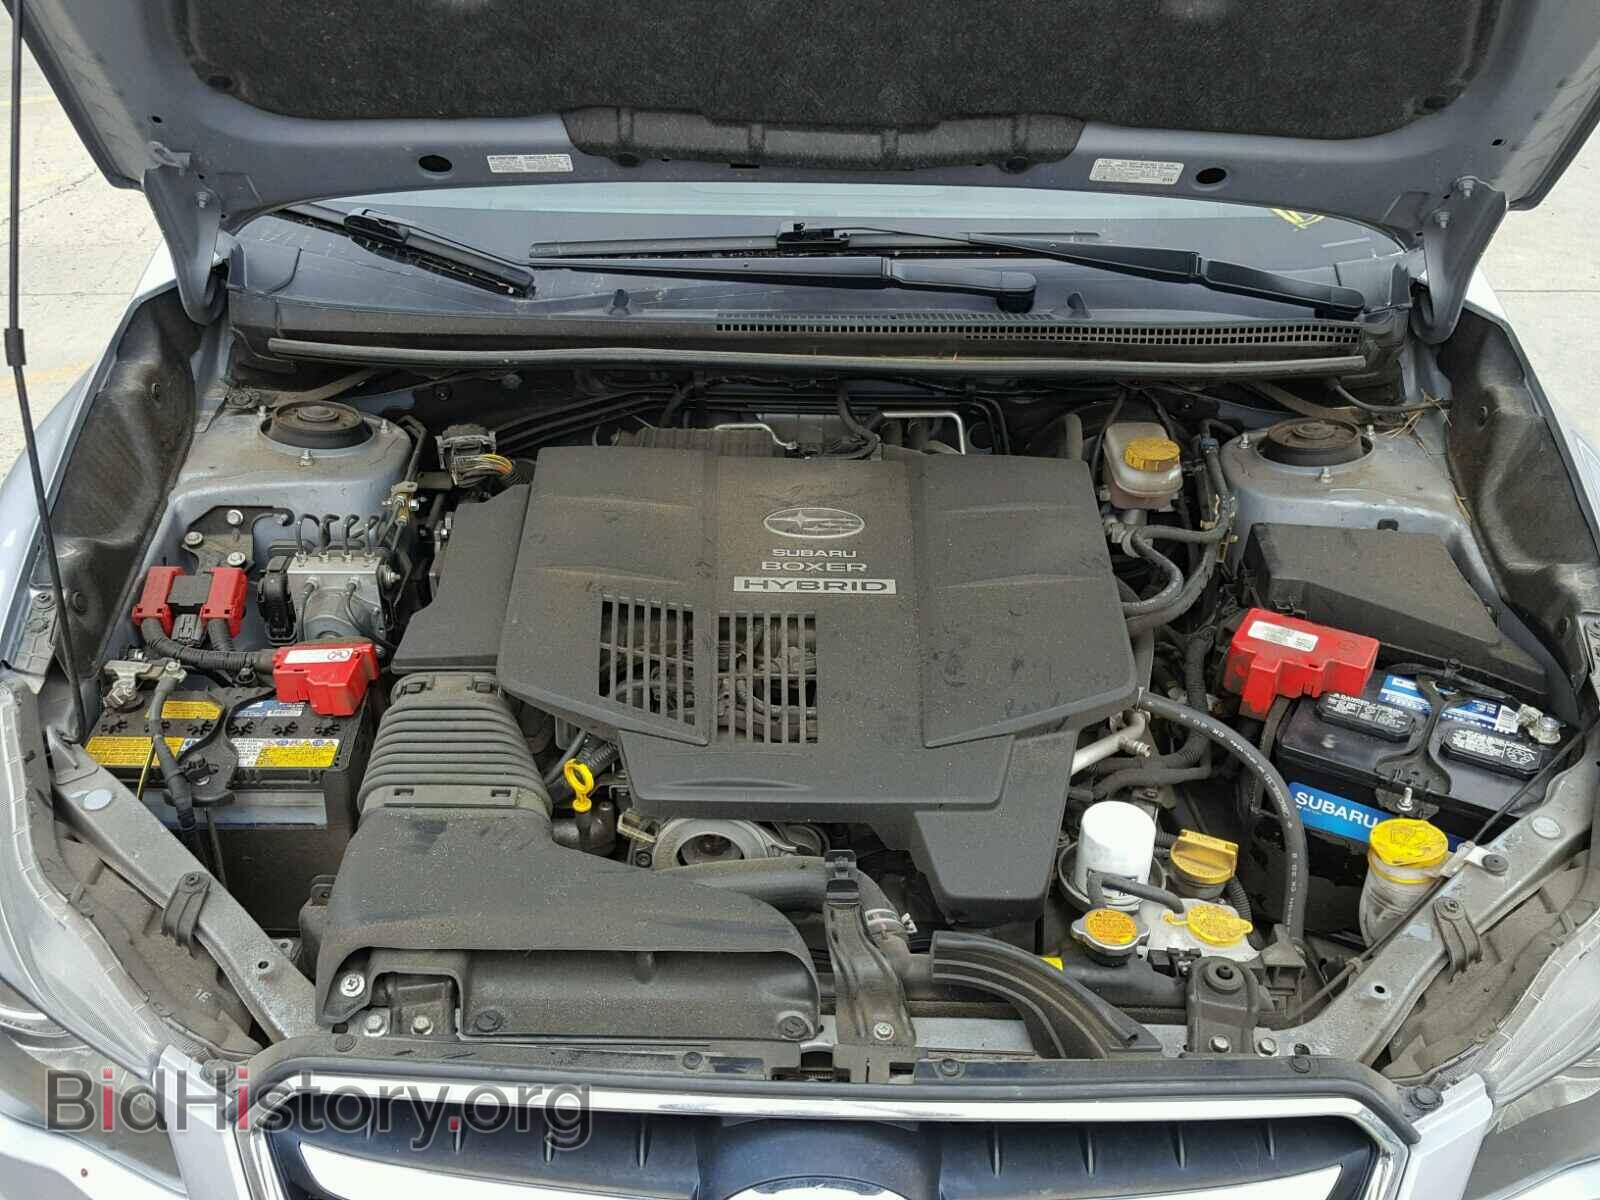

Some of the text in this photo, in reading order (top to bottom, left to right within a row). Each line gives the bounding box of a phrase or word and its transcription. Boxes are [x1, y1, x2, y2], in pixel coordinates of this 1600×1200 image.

[772, 549, 857, 558] SUBARU
[761, 561, 868, 572] BOXER
[743, 579, 887, 591] HYBRID
[1295, 791, 1379, 829] SUBARU
